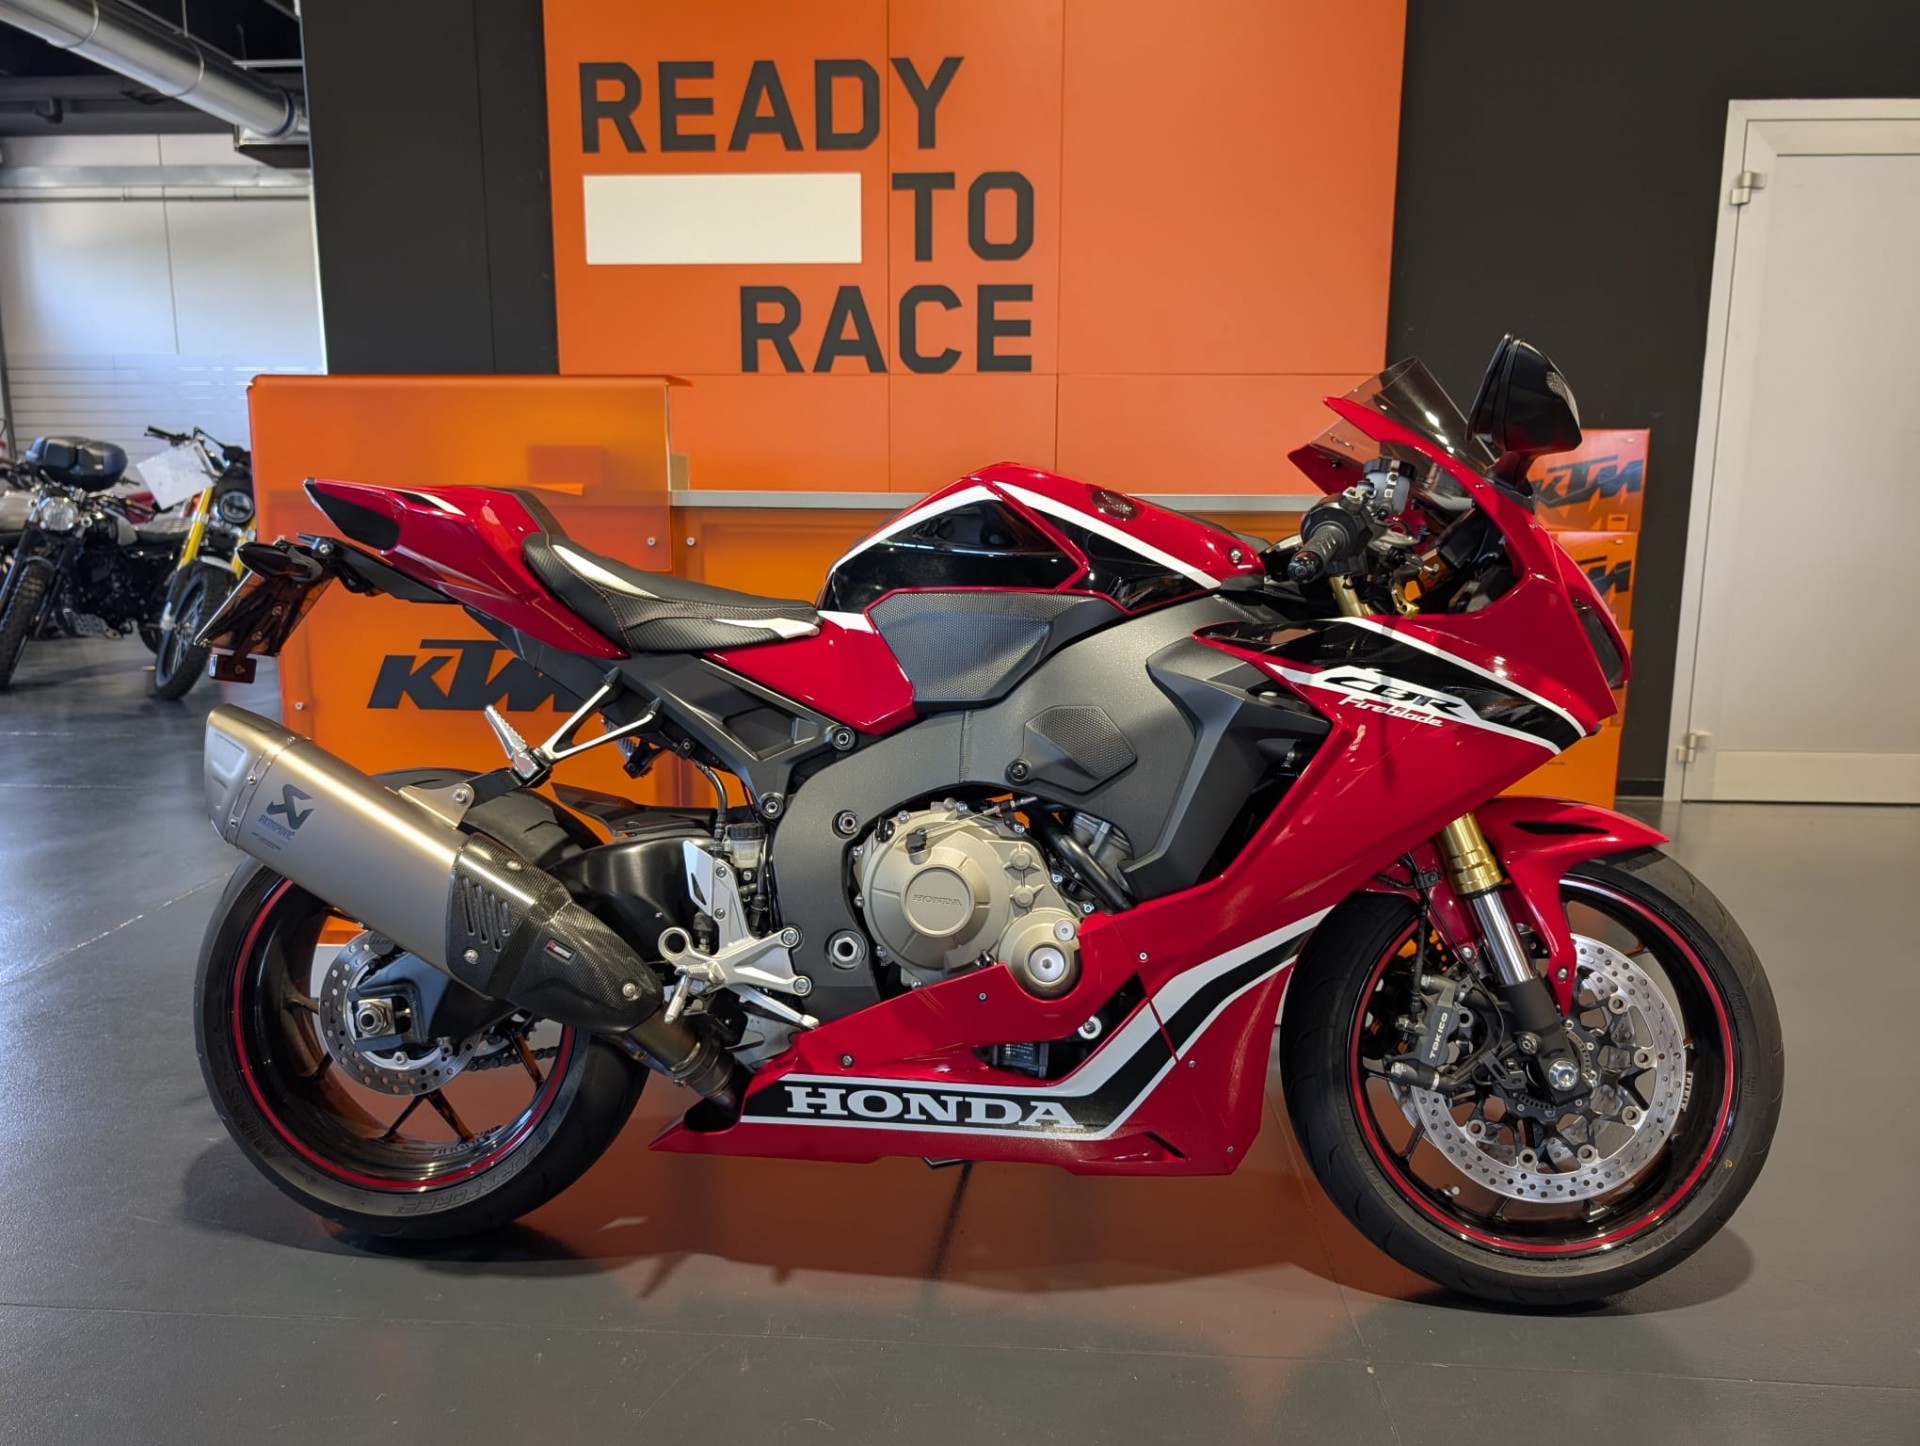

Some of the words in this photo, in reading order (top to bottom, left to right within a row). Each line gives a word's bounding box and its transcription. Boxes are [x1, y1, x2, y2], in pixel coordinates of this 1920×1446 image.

[579, 56, 964, 154] READY
[892, 171, 1034, 262] TO
[740, 284, 1033, 374] RACE
[1530, 455, 1644, 509] KTM
[1322, 675, 1467, 721] CBR
[1338, 696, 1443, 727] Fireblade
[911, 893, 963, 907] HONDA
[1429, 1012, 1448, 1059] TOKICO
[784, 1086, 1084, 1129] HONDA
